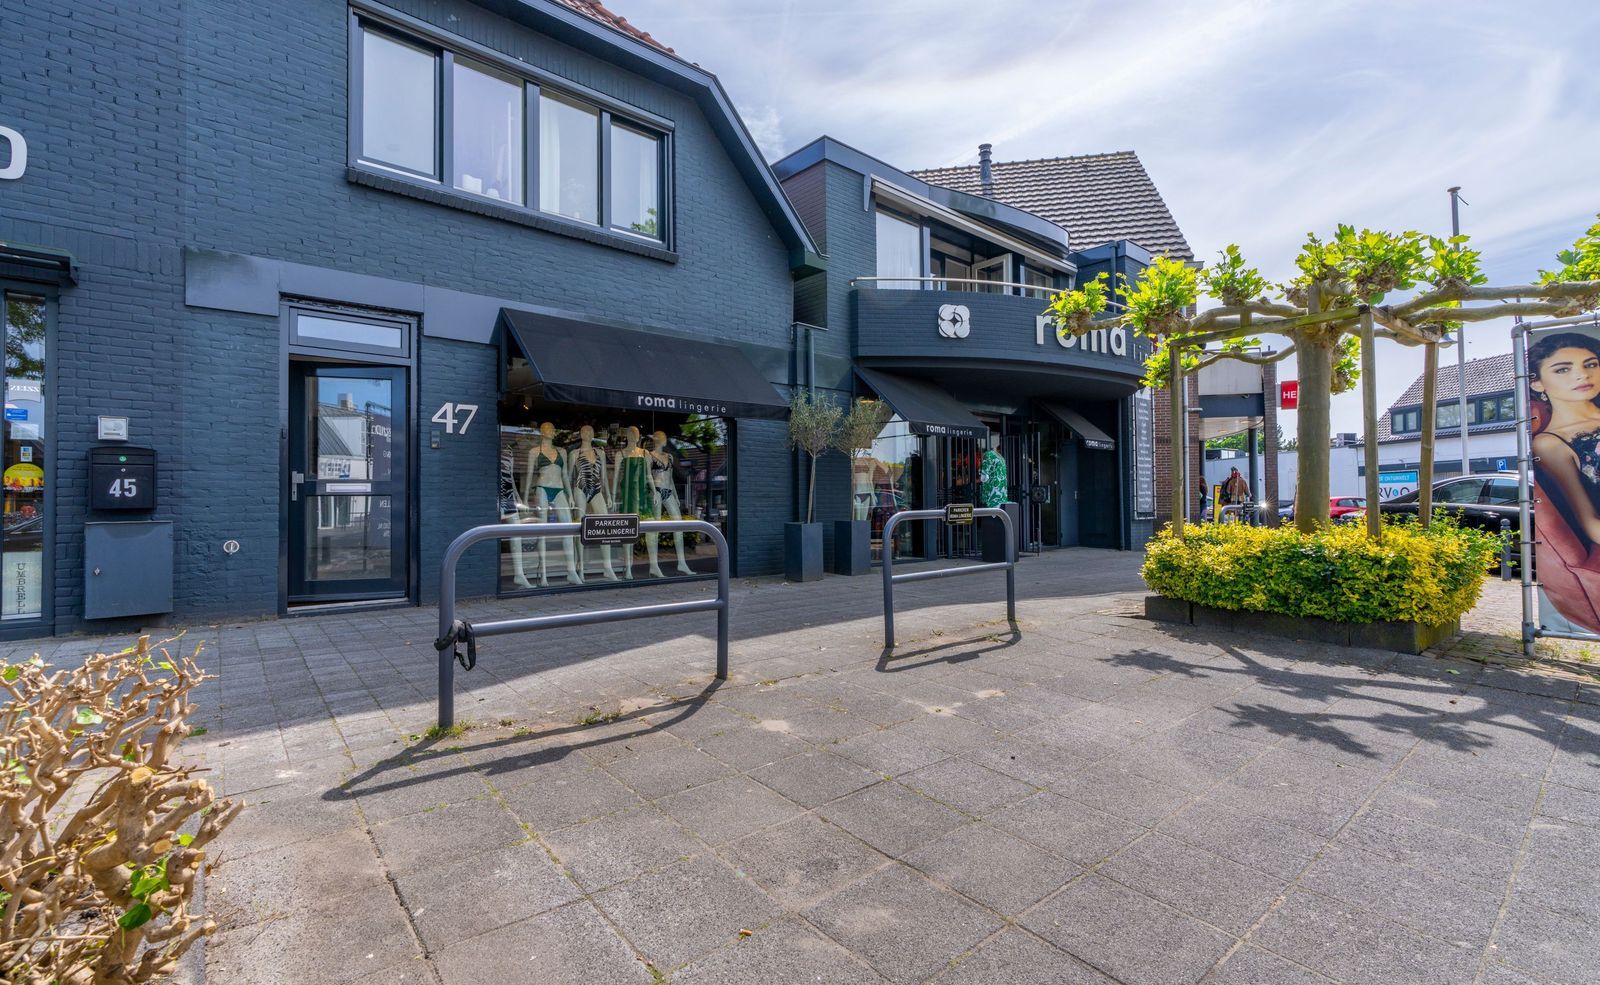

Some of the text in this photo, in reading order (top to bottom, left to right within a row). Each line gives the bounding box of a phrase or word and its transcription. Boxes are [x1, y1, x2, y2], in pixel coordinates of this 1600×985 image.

[1036, 315, 1127, 356] roma
[10, 384, 40, 392] ZEISS
[637, 395, 727, 413] roma lingerie
[431, 402, 479, 435] 47
[926, 425, 973, 437] roma lingerie
[1498, 460, 1504, 470] P
[109, 478, 137, 497] 45
[587, 528, 636, 536] ROMA LINGERIE
